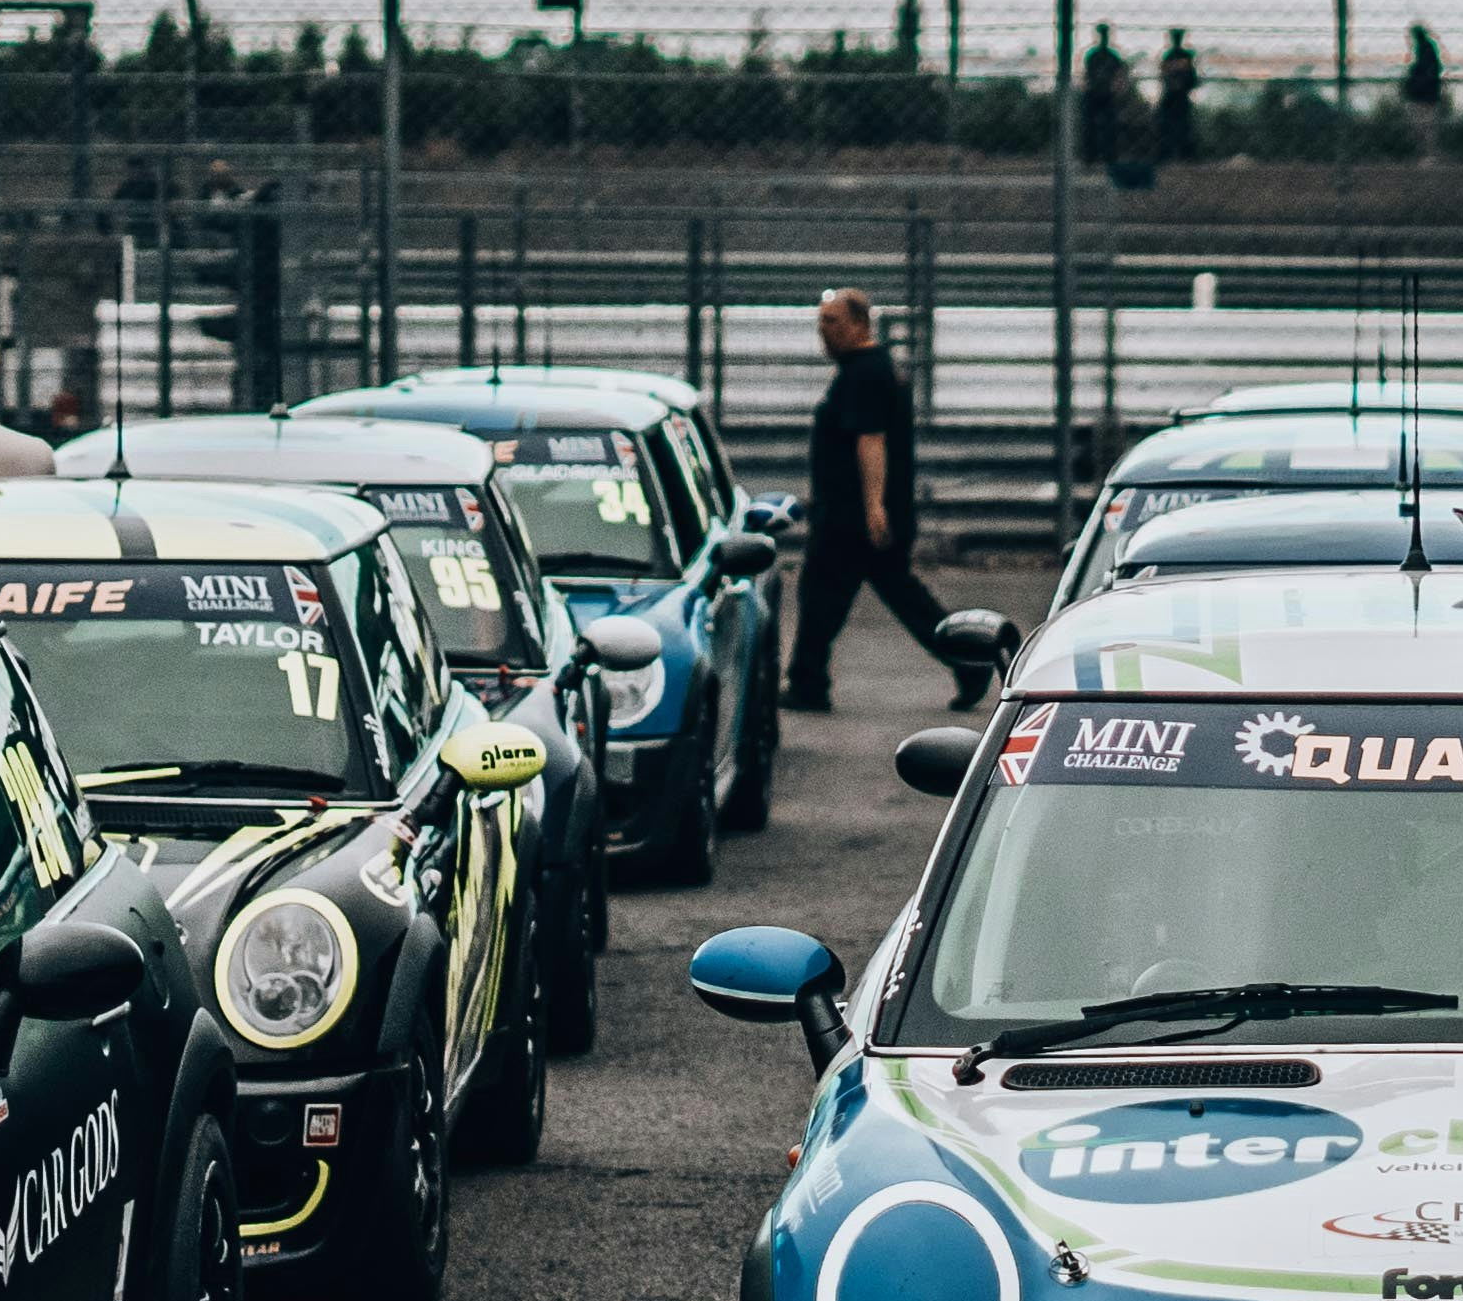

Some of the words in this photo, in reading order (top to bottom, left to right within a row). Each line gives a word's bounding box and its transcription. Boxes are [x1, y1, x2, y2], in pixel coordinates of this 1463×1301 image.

[421, 539, 486, 559] KING
[181, 575, 273, 601] MINI
[429, 556, 502, 611] 95
[194, 621, 325, 654] TAYLOR
[277, 650, 340, 722] 17
[1071, 718, 1197, 757] MINI
[1063, 753, 1182, 773] CHALLENGE
[1047, 1124, 1359, 1181] inter
[23, 1148, 68, 1264] CAR
[69, 1087, 120, 1219] GODS
